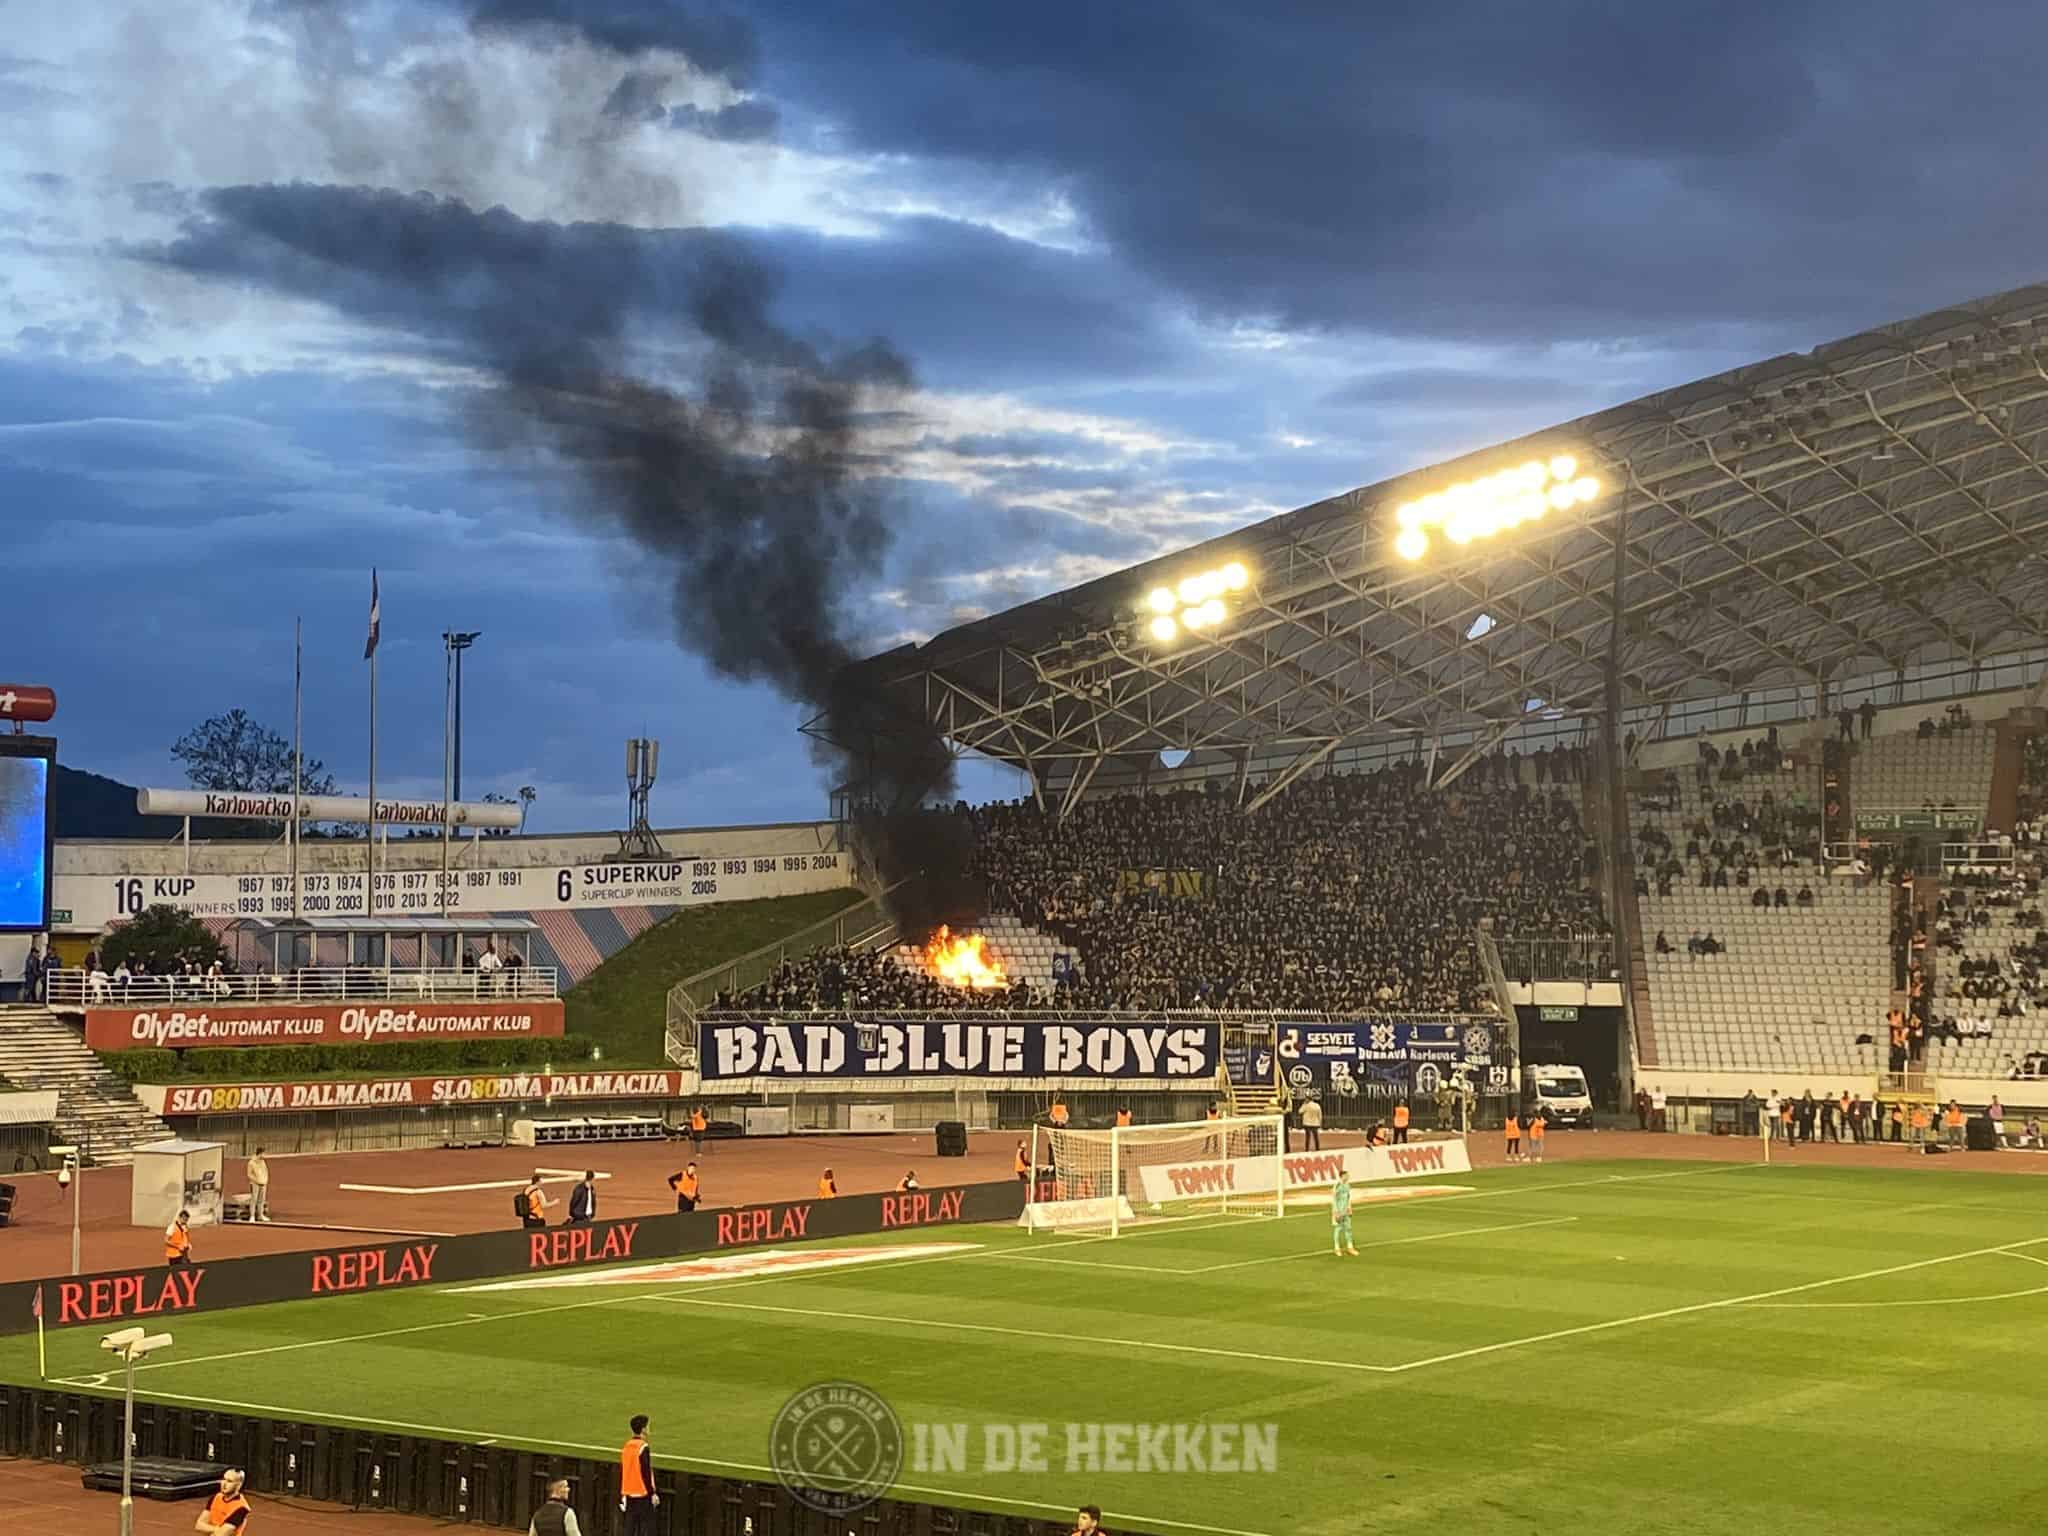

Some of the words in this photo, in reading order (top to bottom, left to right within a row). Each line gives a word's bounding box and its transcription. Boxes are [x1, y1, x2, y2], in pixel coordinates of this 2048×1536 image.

[205, 794, 291, 817] Karlovačko
[583, 865, 682, 885] SUPERKUP
[692, 862, 716, 876] 1992
[723, 860, 747, 875] 1993
[753, 859, 777, 873] 1994
[783, 857, 808, 871] 1995
[812, 856, 838, 869] 2004
[115, 878, 144, 914] 16
[154, 878, 196, 897] KUP
[238, 877, 264, 893] 1967
[271, 876, 296, 892] 1972
[304, 876, 330, 891] 1973
[337, 875, 362, 890] 1974
[374, 874, 396, 889] 976
[402, 873, 428, 888] 1977
[466, 872, 491, 886] 1987
[498, 871, 522, 885] 1991
[557, 869, 572, 901] 6
[581, 888, 635, 901] SUPERCUP
[636, 886, 683, 898] WINNERS
[691, 880, 717, 895] 2005
[237, 897, 264, 912] 1993
[303, 896, 330, 911] 2000
[336, 895, 362, 910] 2003
[374, 893, 395, 908] 010
[401, 893, 427, 908] 2013
[131, 1012, 209, 1047] OlyBet
[208, 1019, 283, 1037] AUTOMAT
[284, 1018, 325, 1035] KLUB
[339, 1008, 417, 1041] OlyBet
[416, 1016, 491, 1033] AUTOMAT
[493, 1015, 532, 1031] KLUB
[714, 1024, 846, 1075] BAD
[863, 1022, 1025, 1075] BLUE
[1042, 1026, 1207, 1075] BOYS
[171, 1087, 284, 1112] SLO80DNA
[290, 1081, 414, 1107] DALMACIJA
[549, 1074, 670, 1096] DALMACIJA
[1283, 1154, 1345, 1185] TOMMY
[1388, 1145, 1445, 1174] TOMMY
[1168, 1164, 1235, 1195] TOMMY
[881, 1191, 966, 1227] REPLAY
[716, 1206, 811, 1246] REPLAY
[529, 1223, 638, 1268] REPLAY
[311, 1243, 440, 1293] REPLAY
[59, 1269, 207, 1323] REPLAY
